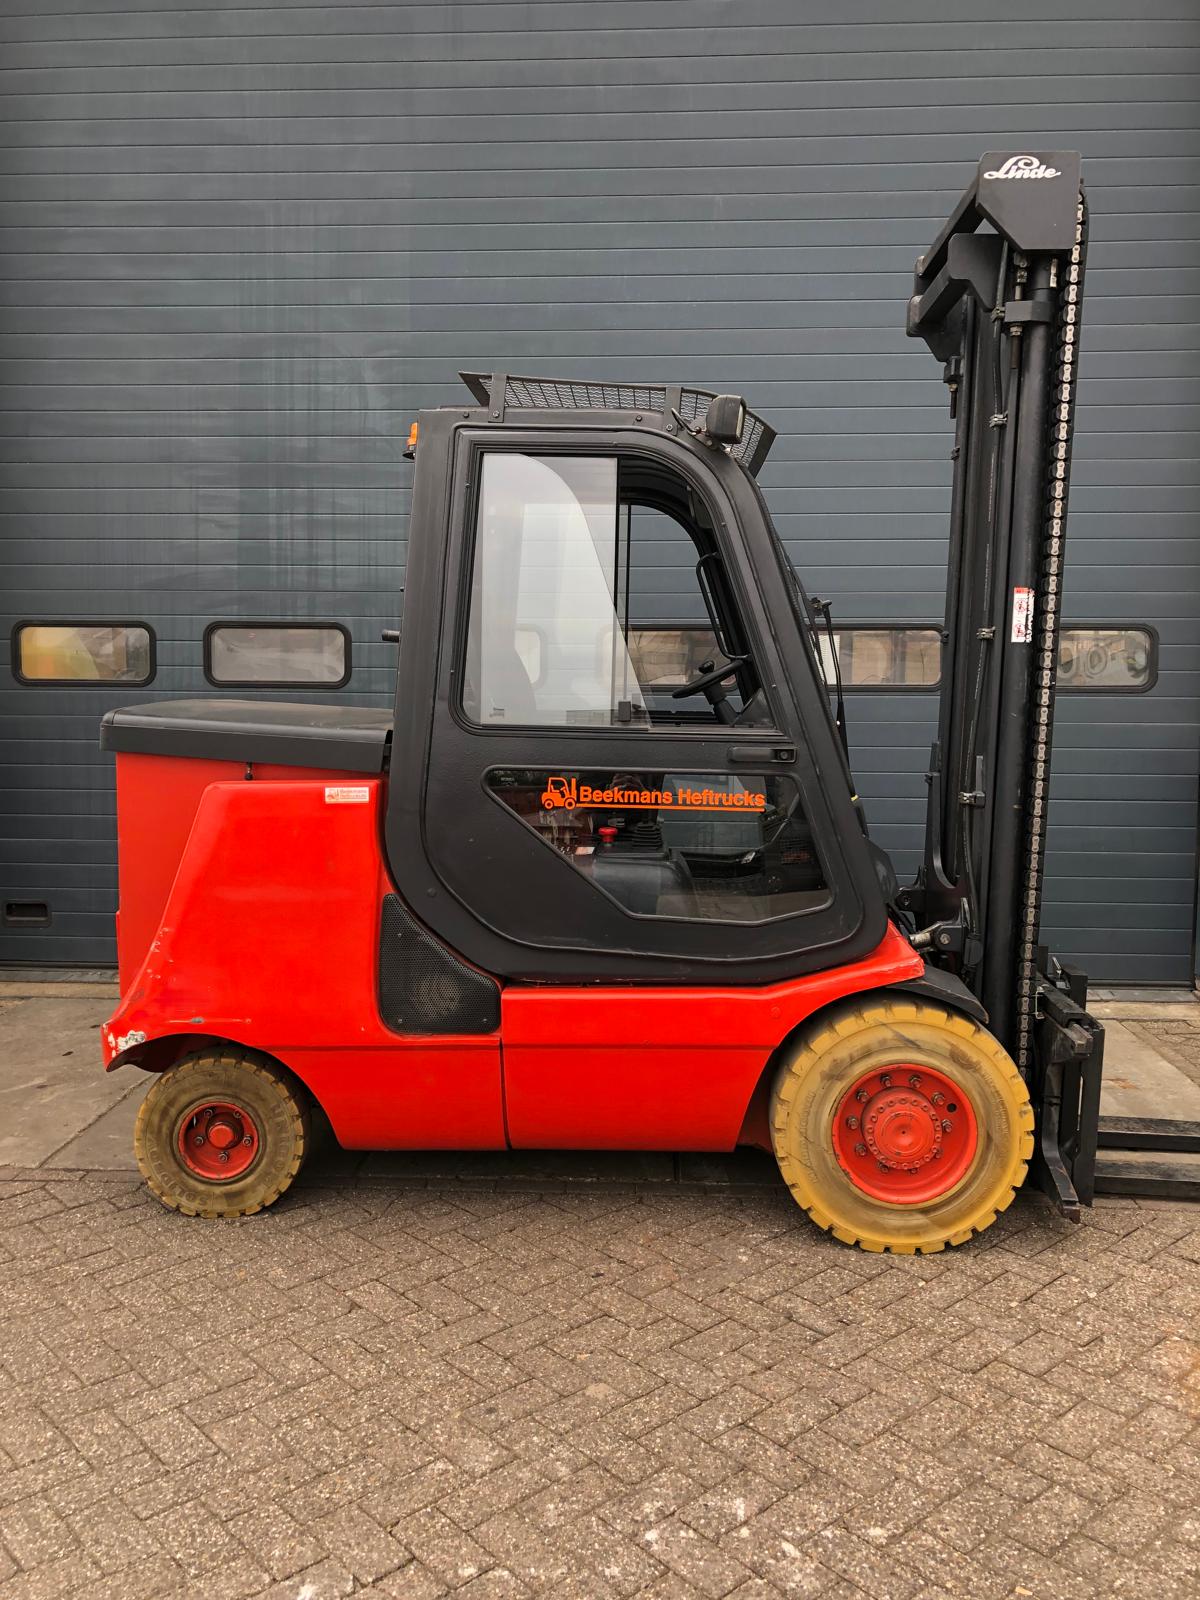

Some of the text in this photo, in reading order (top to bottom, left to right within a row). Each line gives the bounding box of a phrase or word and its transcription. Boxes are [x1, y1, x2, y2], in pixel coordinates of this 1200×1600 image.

[983, 155, 1062, 179] Linde
[580, 786, 765, 807] Beekmans Heftrucks
